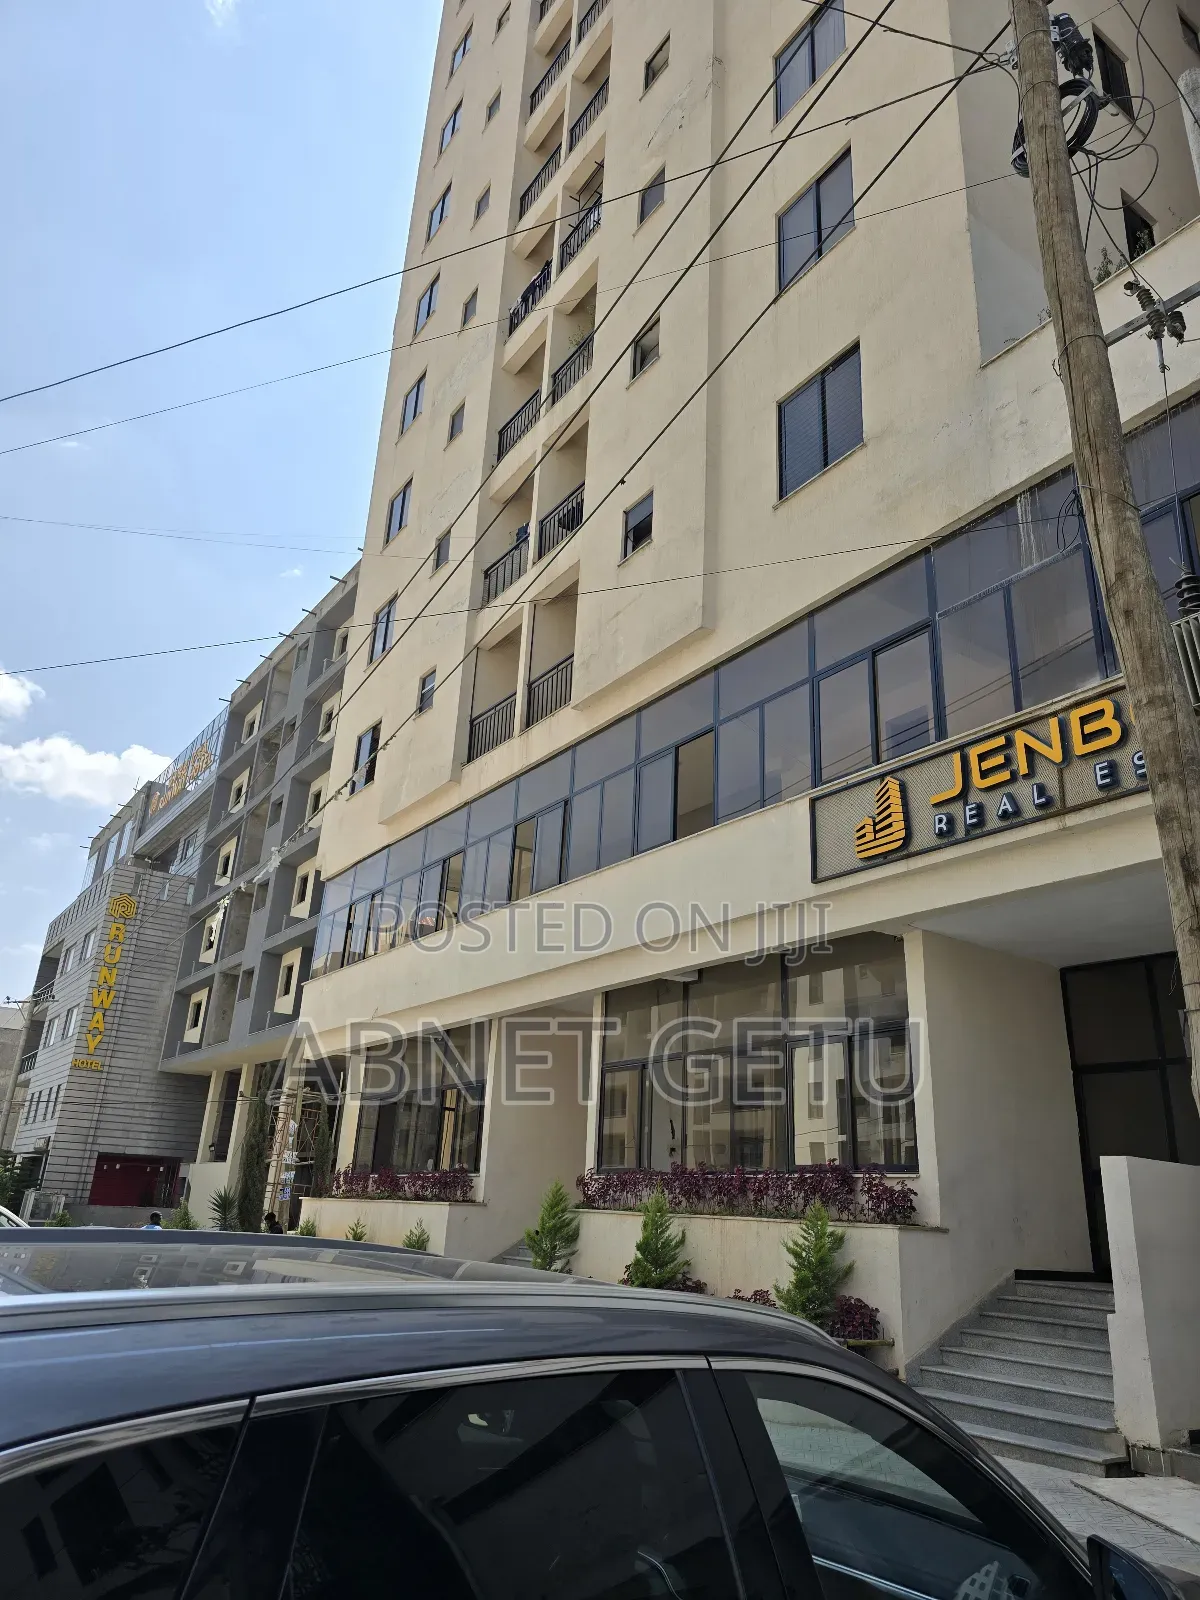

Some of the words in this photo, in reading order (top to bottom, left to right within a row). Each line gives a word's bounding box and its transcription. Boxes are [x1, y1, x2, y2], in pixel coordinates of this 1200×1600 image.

[930, 699, 1136, 805] JENB
[935, 782, 1046, 836] REAL
[86, 923, 126, 1055] RUNWAY
[71, 1058, 104, 1071] HOTEL
